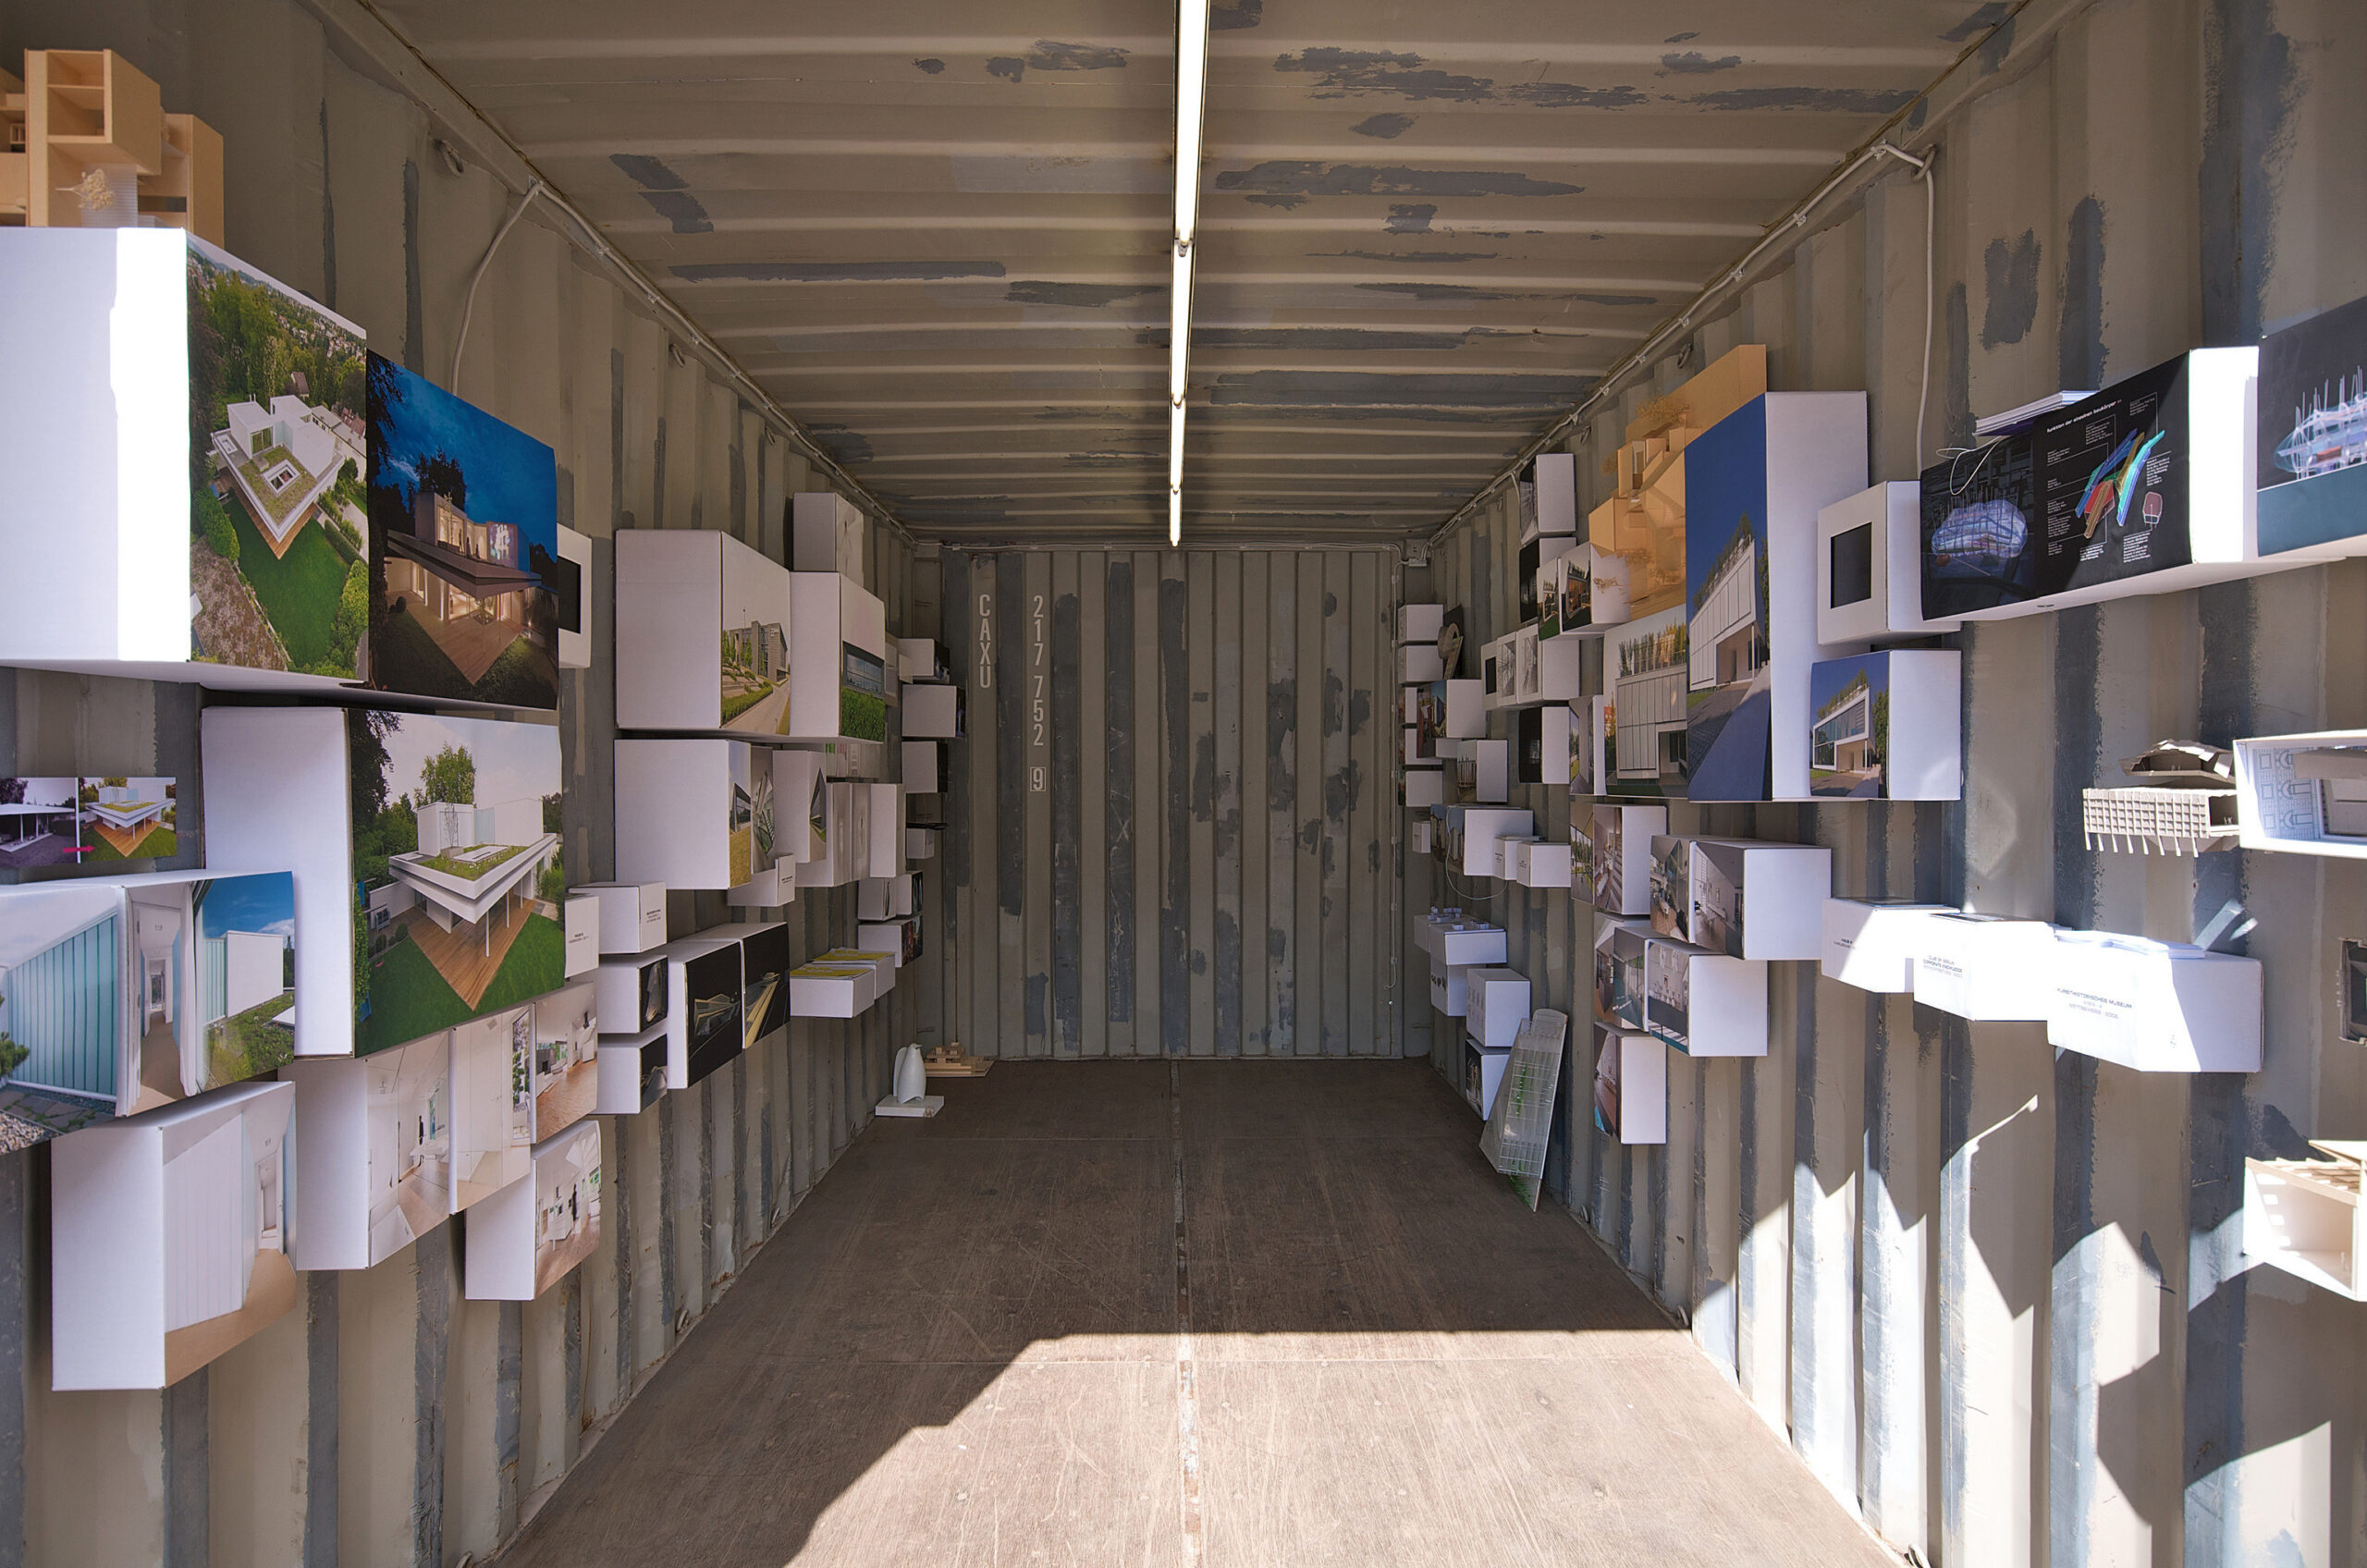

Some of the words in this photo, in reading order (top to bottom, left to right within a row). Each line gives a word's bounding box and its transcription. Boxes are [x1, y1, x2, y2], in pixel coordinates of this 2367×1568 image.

[979, 594, 991, 689] CAXU
[1033, 767, 1044, 790] 9
[2057, 988, 2108, 1003] KUNSTHISTORISCHES
[2109, 999, 2132, 1009] MUSEUM
